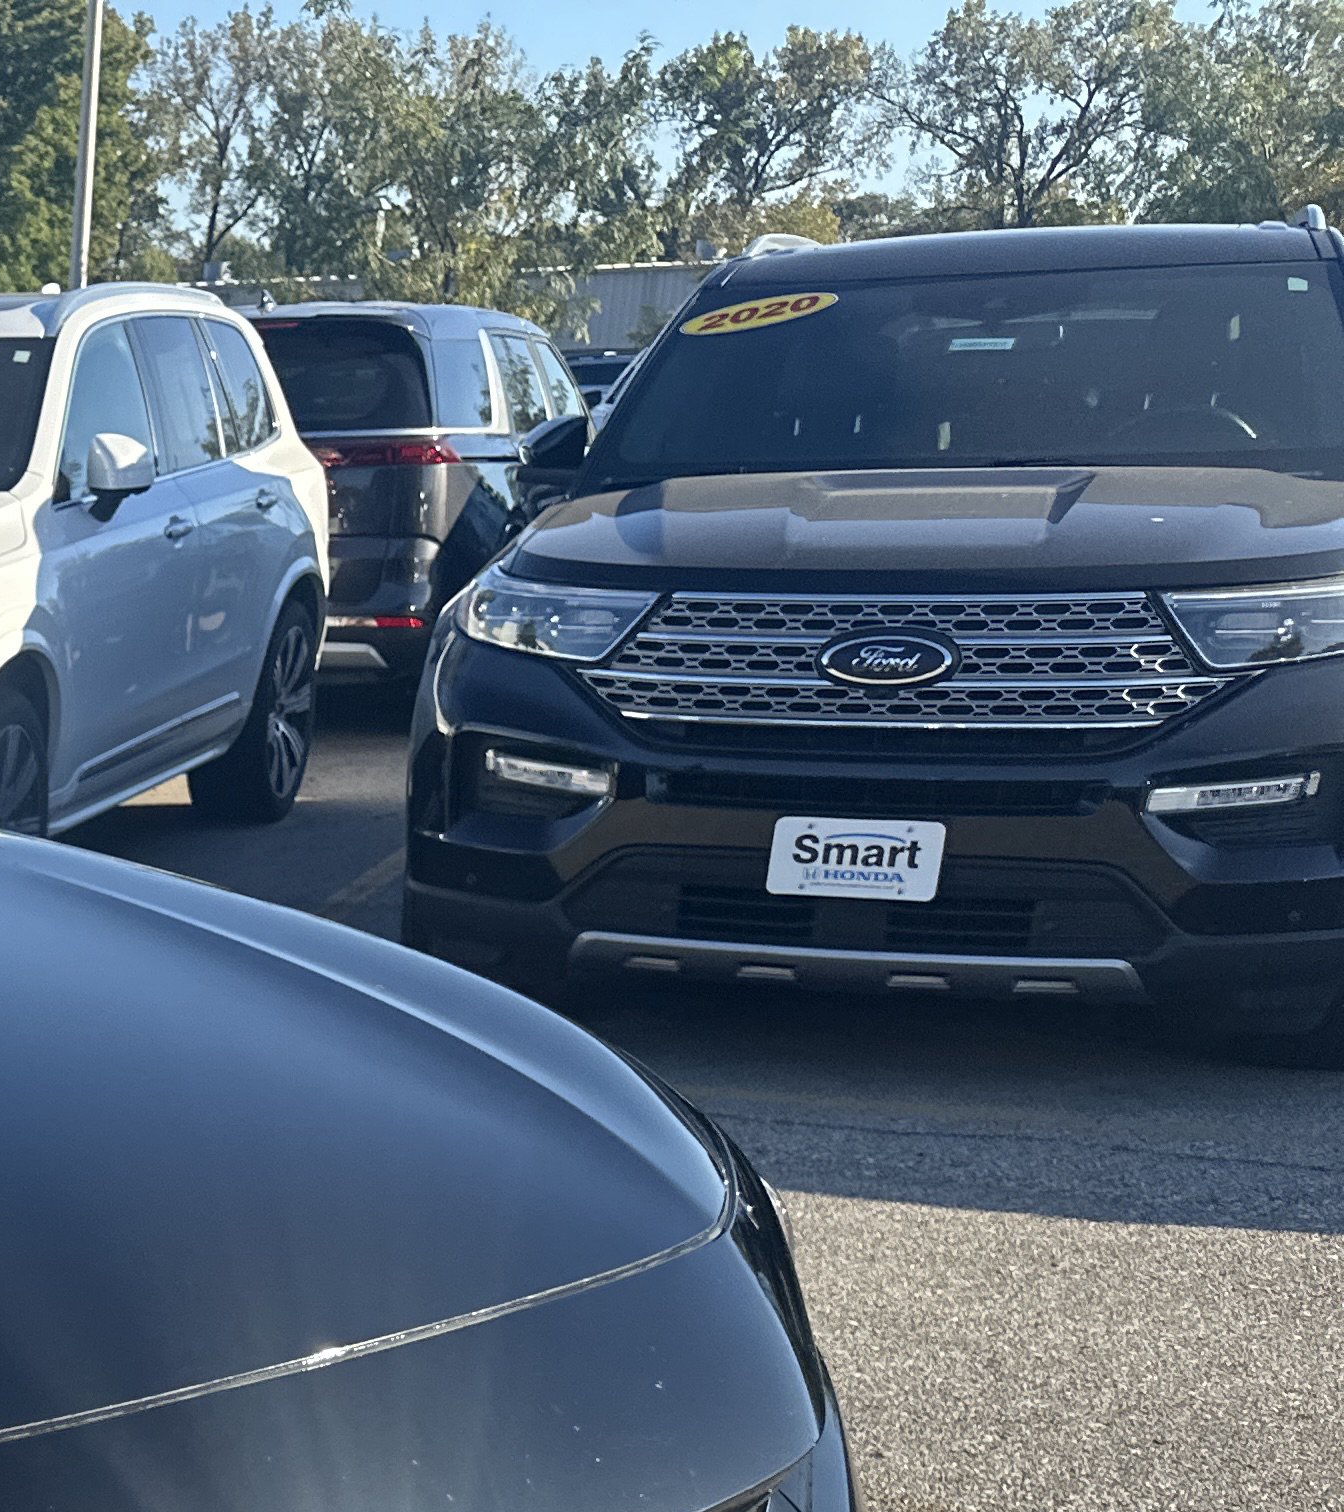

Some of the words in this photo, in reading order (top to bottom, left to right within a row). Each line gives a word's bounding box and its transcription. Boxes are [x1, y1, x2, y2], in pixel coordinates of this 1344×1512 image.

[697, 295, 821, 332] 2020
[851, 645, 921, 672] Ford
[792, 833, 922, 869] Smart
[823, 868, 905, 883] HONDA
